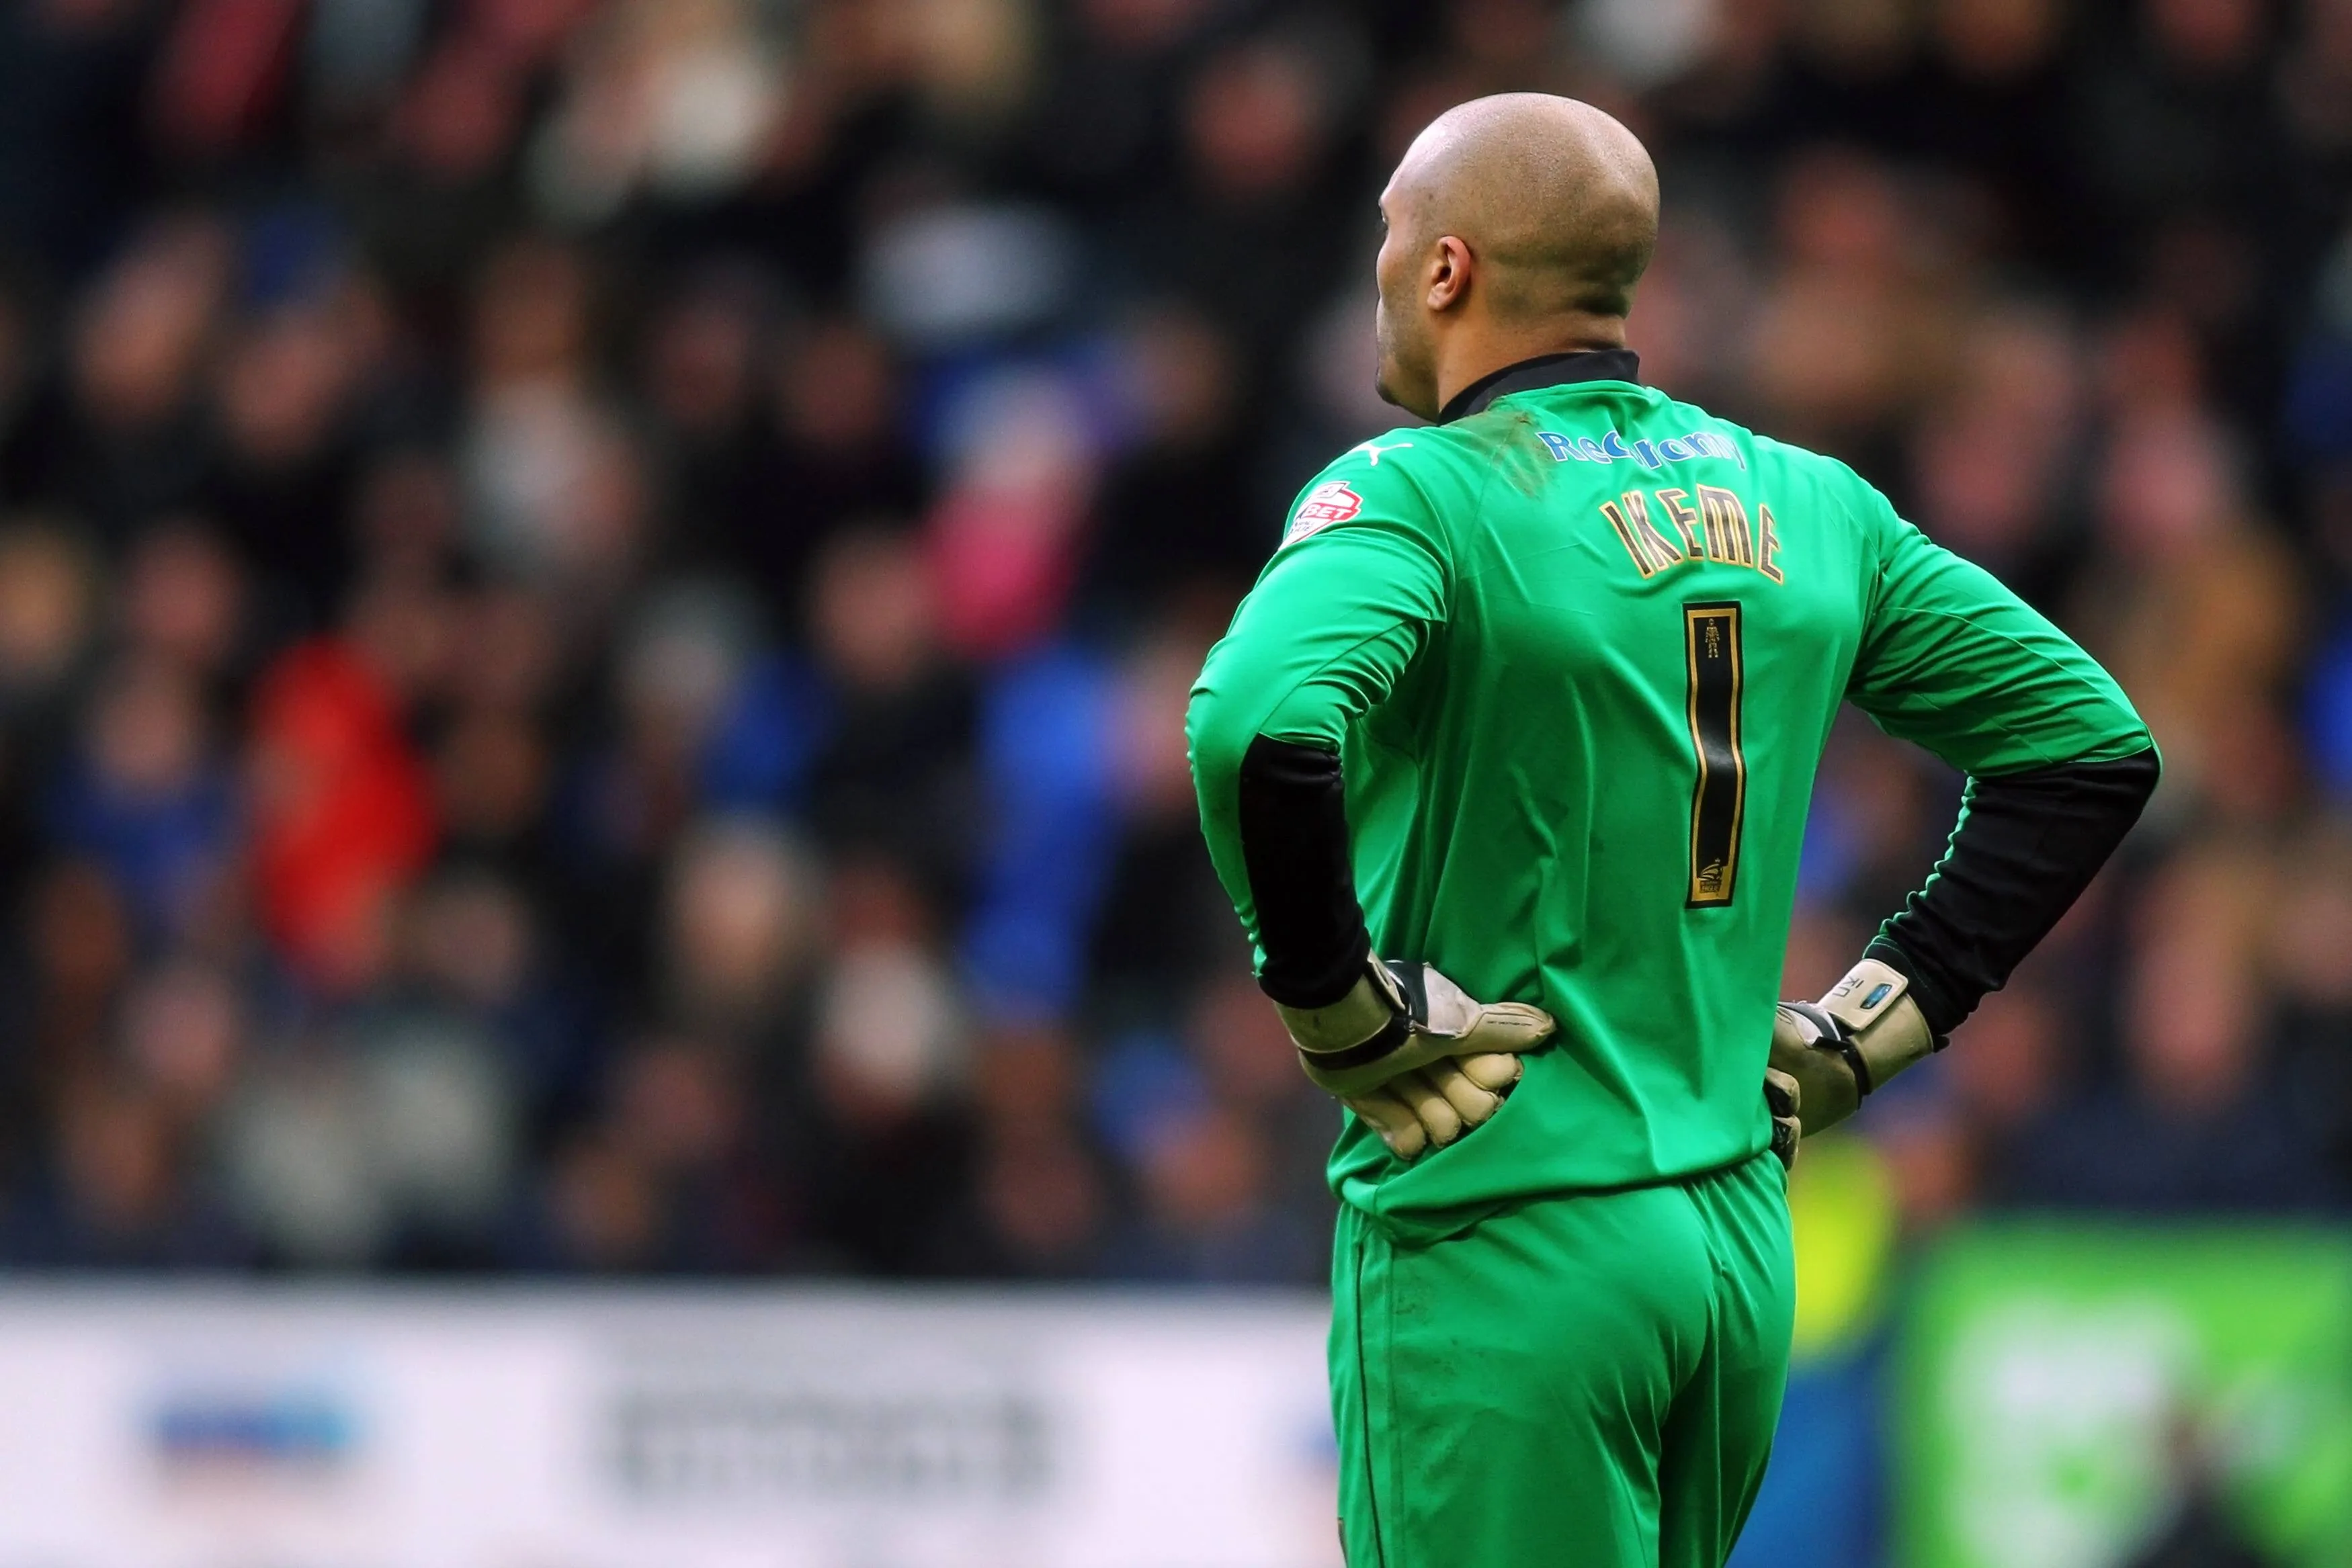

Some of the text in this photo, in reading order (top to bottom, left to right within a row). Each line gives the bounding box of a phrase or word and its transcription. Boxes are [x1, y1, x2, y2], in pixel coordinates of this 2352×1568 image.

[1302, 504, 1353, 520] BET
[1599, 483, 1784, 584] IKEME
[1682, 601, 1747, 910] 1
